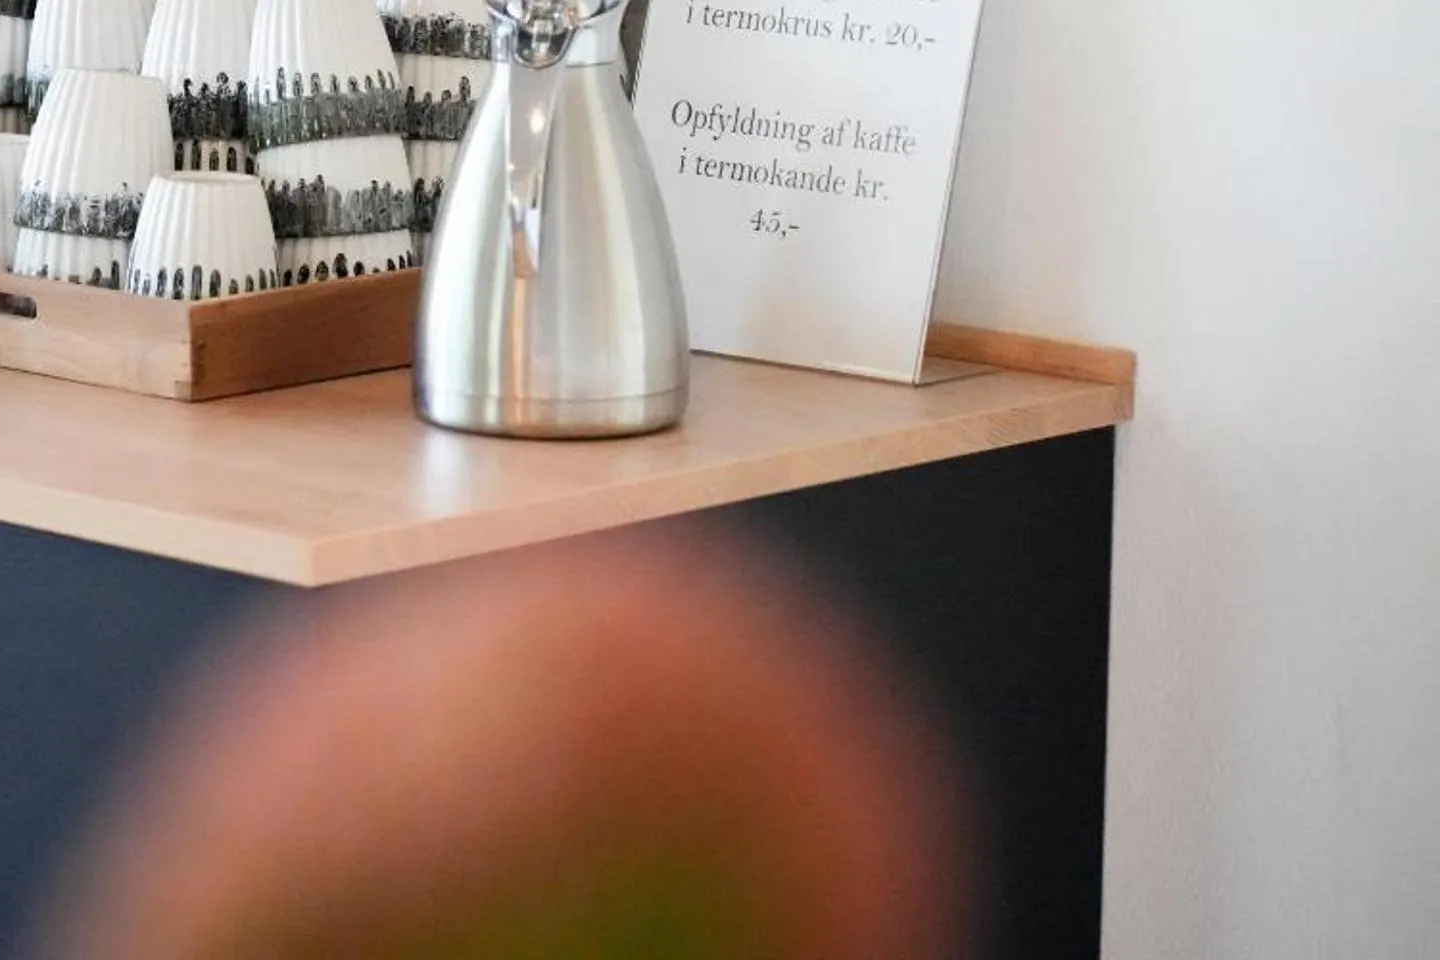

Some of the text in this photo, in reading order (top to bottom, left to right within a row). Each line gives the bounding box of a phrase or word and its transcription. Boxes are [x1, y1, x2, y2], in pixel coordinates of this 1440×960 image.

[703, 4, 832, 40] termokrus
[841, 12, 875, 44] kr.
[885, 24, 936, 51] 20,-
[670, 100, 916, 156] Opfyldning af kaffe
[678, 148, 888, 201] i termokande kr.
[749, 208, 800, 238] 45,-
